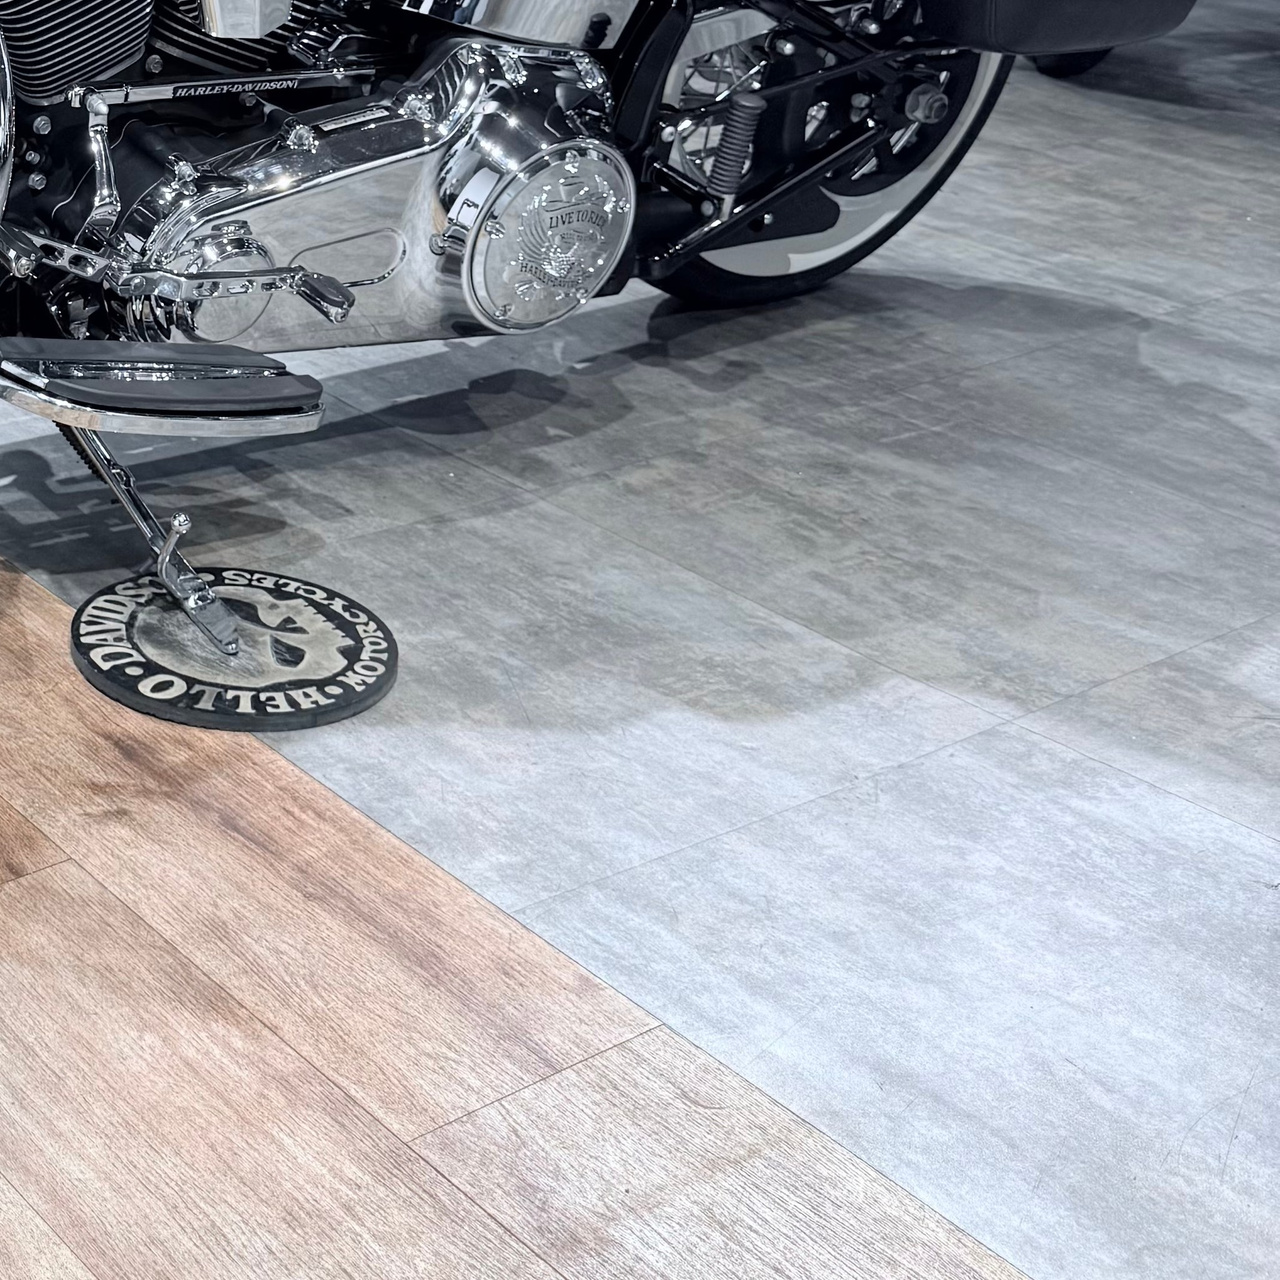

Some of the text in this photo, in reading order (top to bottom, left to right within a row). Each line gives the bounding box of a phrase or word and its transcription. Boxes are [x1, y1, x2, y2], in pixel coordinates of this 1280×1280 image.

[175, 79, 299, 97] HARLEY-DAVIDSON
[549, 211, 575, 229] LIVE
[576, 209, 589, 223] TO
[221, 570, 389, 692] MOTORCYCLES
[137, 673, 337, 714] HELLO
